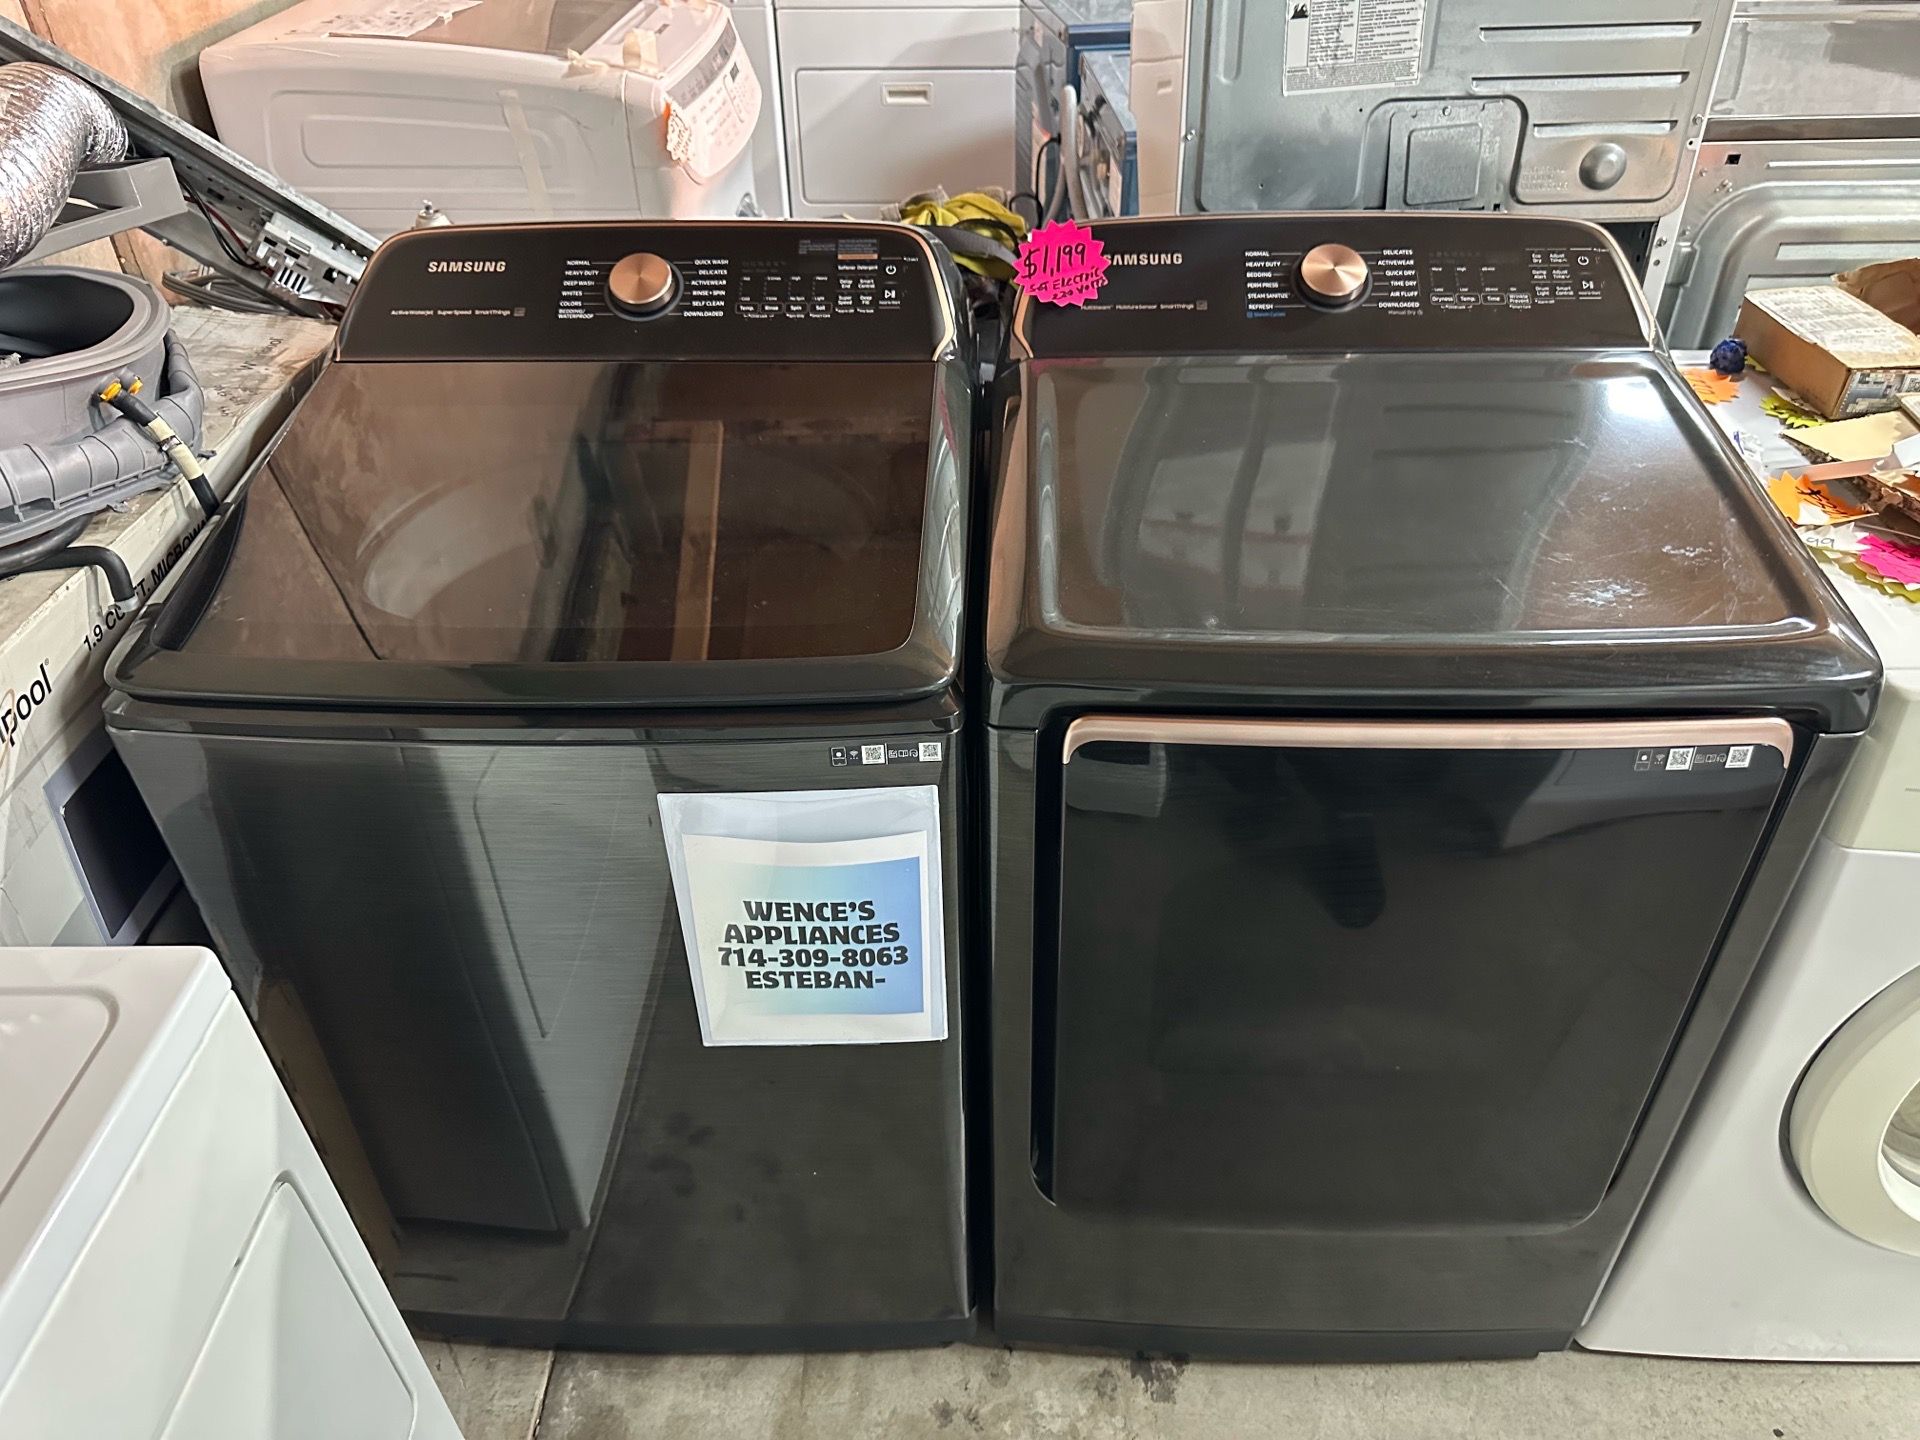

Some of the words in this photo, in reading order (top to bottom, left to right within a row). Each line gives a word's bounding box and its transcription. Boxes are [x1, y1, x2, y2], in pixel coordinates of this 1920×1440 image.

[428, 261, 506, 273] SAMSUNG
[1021, 242, 1086, 279] $1,199
[83, 625, 103, 651] 1.9
[743, 900, 876, 922] WENCE'S
[724, 923, 900, 944] APPLIANCES
[718, 946, 909, 967] 714-309-8063
[745, 971, 886, 988] ESTEBAN-
